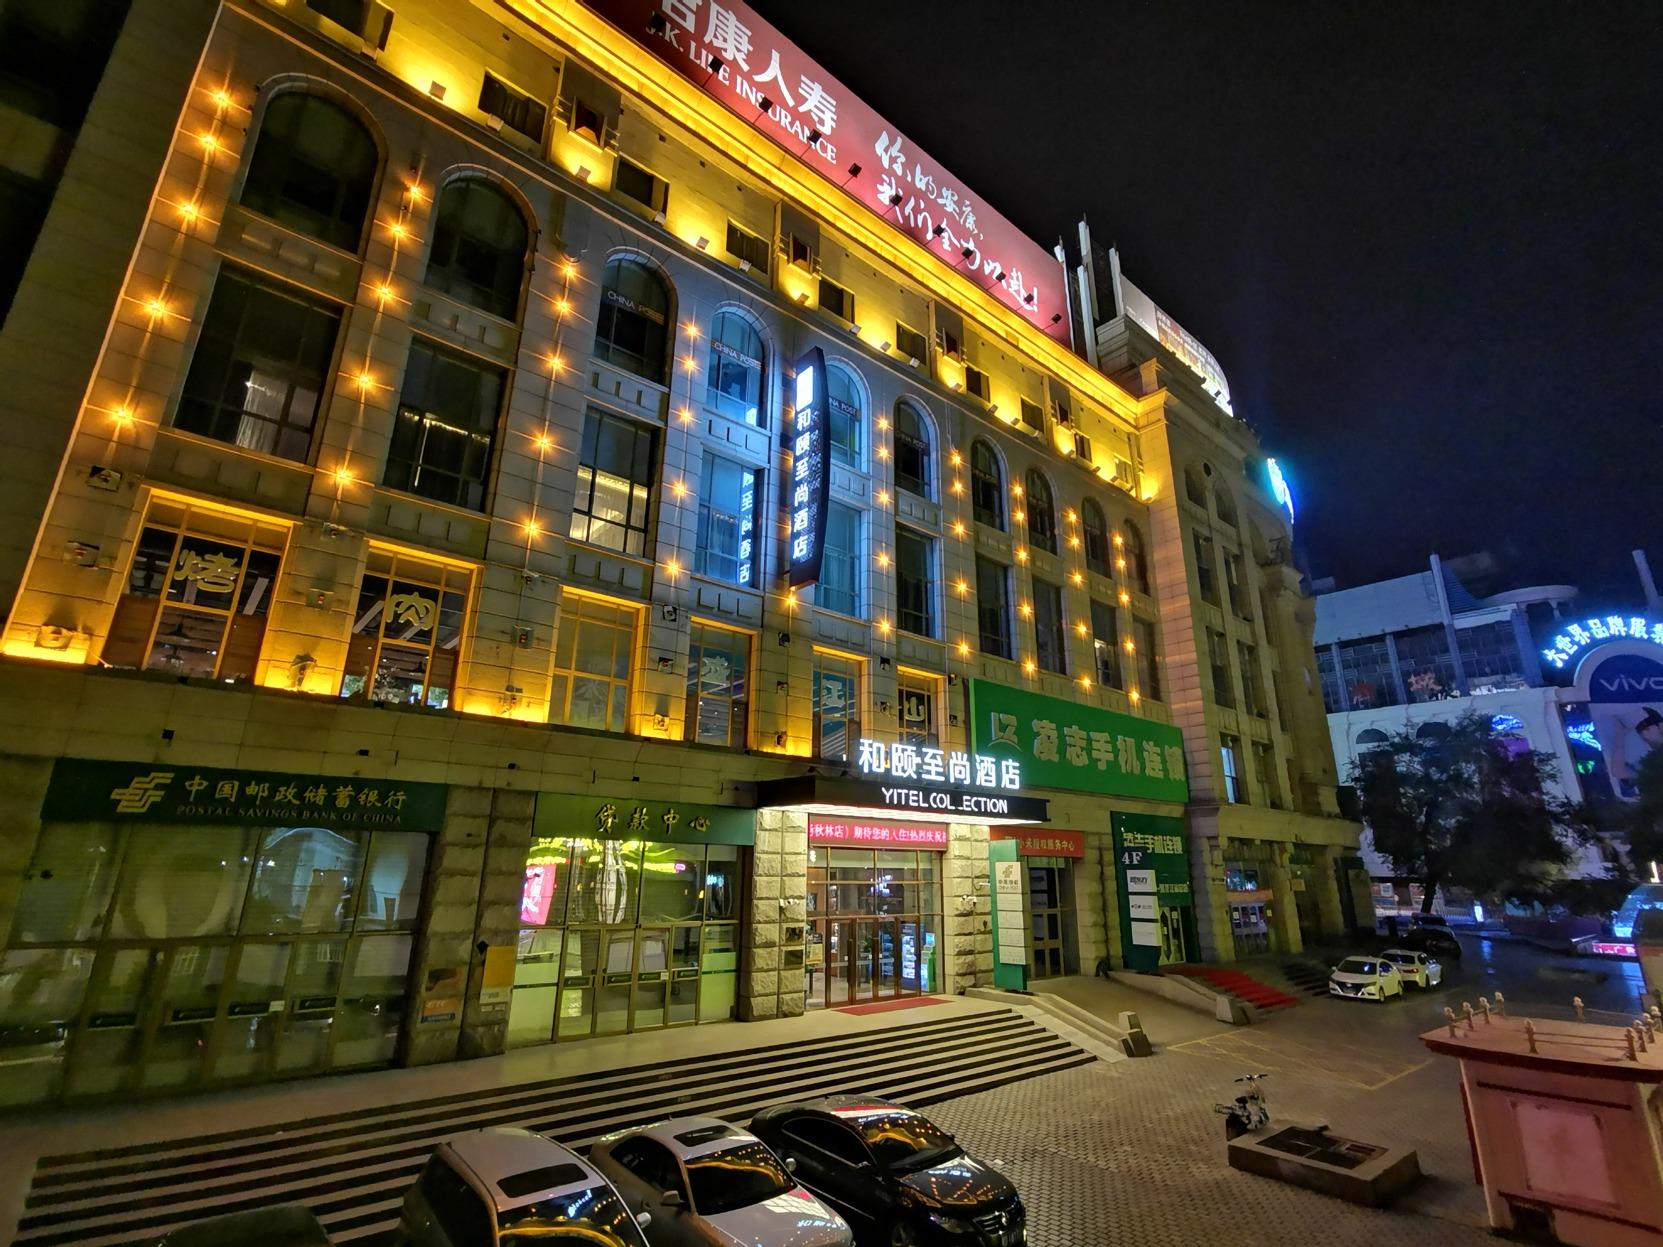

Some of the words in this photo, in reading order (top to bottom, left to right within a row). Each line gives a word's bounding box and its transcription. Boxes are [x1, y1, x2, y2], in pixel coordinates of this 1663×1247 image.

[736, 75, 837, 164] INSURANCE
[792, 408, 811, 560] 和颐至尚酒店
[858, 738, 1021, 790] 和颐至尚酒店
[184, 775, 407, 810] 中国邮政储蓄银行
[881, 787, 929, 808] YITEL
[176, 803, 232, 817] POSTAL
[238, 807, 297, 820] SAVINGS
[301, 810, 337, 821] BANK
[342, 812, 358, 822] OF
[363, 812, 402, 824] CHINA
[595, 803, 711, 835] 贷款中心
[1121, 851, 1143, 865] 4F
